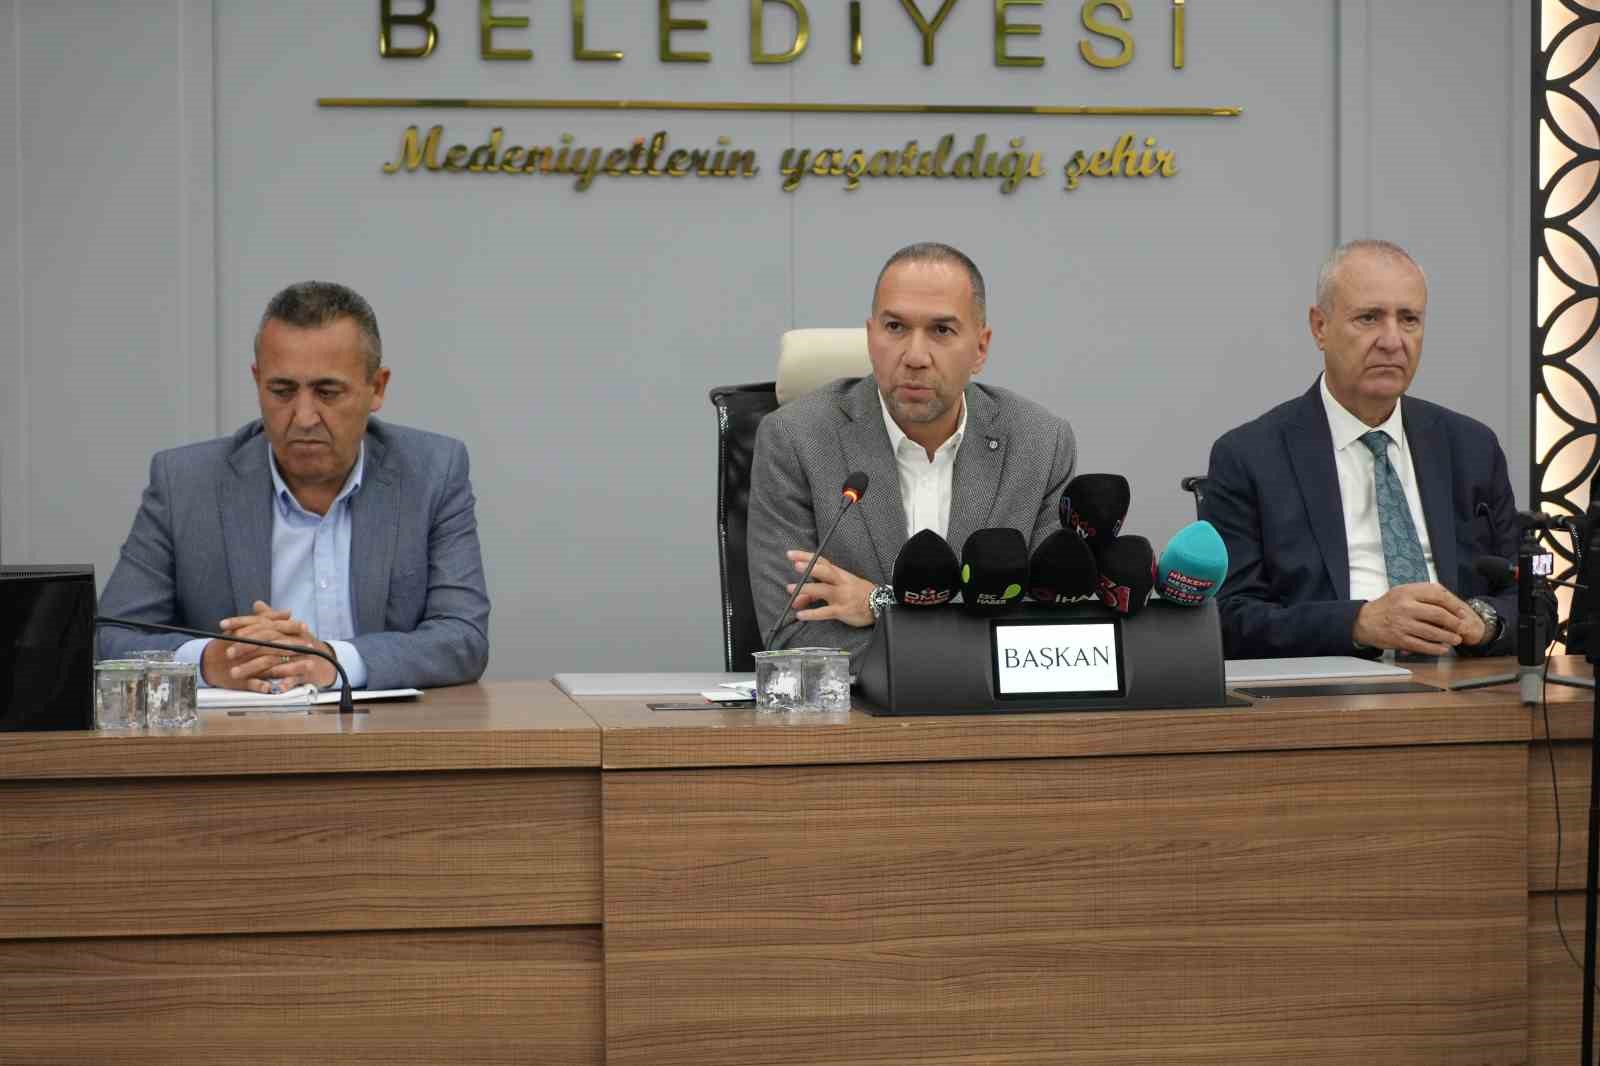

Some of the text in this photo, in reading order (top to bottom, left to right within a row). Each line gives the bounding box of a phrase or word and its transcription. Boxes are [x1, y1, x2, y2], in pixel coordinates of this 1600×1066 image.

[383, 125, 1179, 194] Medeniyetlerin yaşatıldığı şehir
[1005, 646, 1109, 670] BAŞKAN
